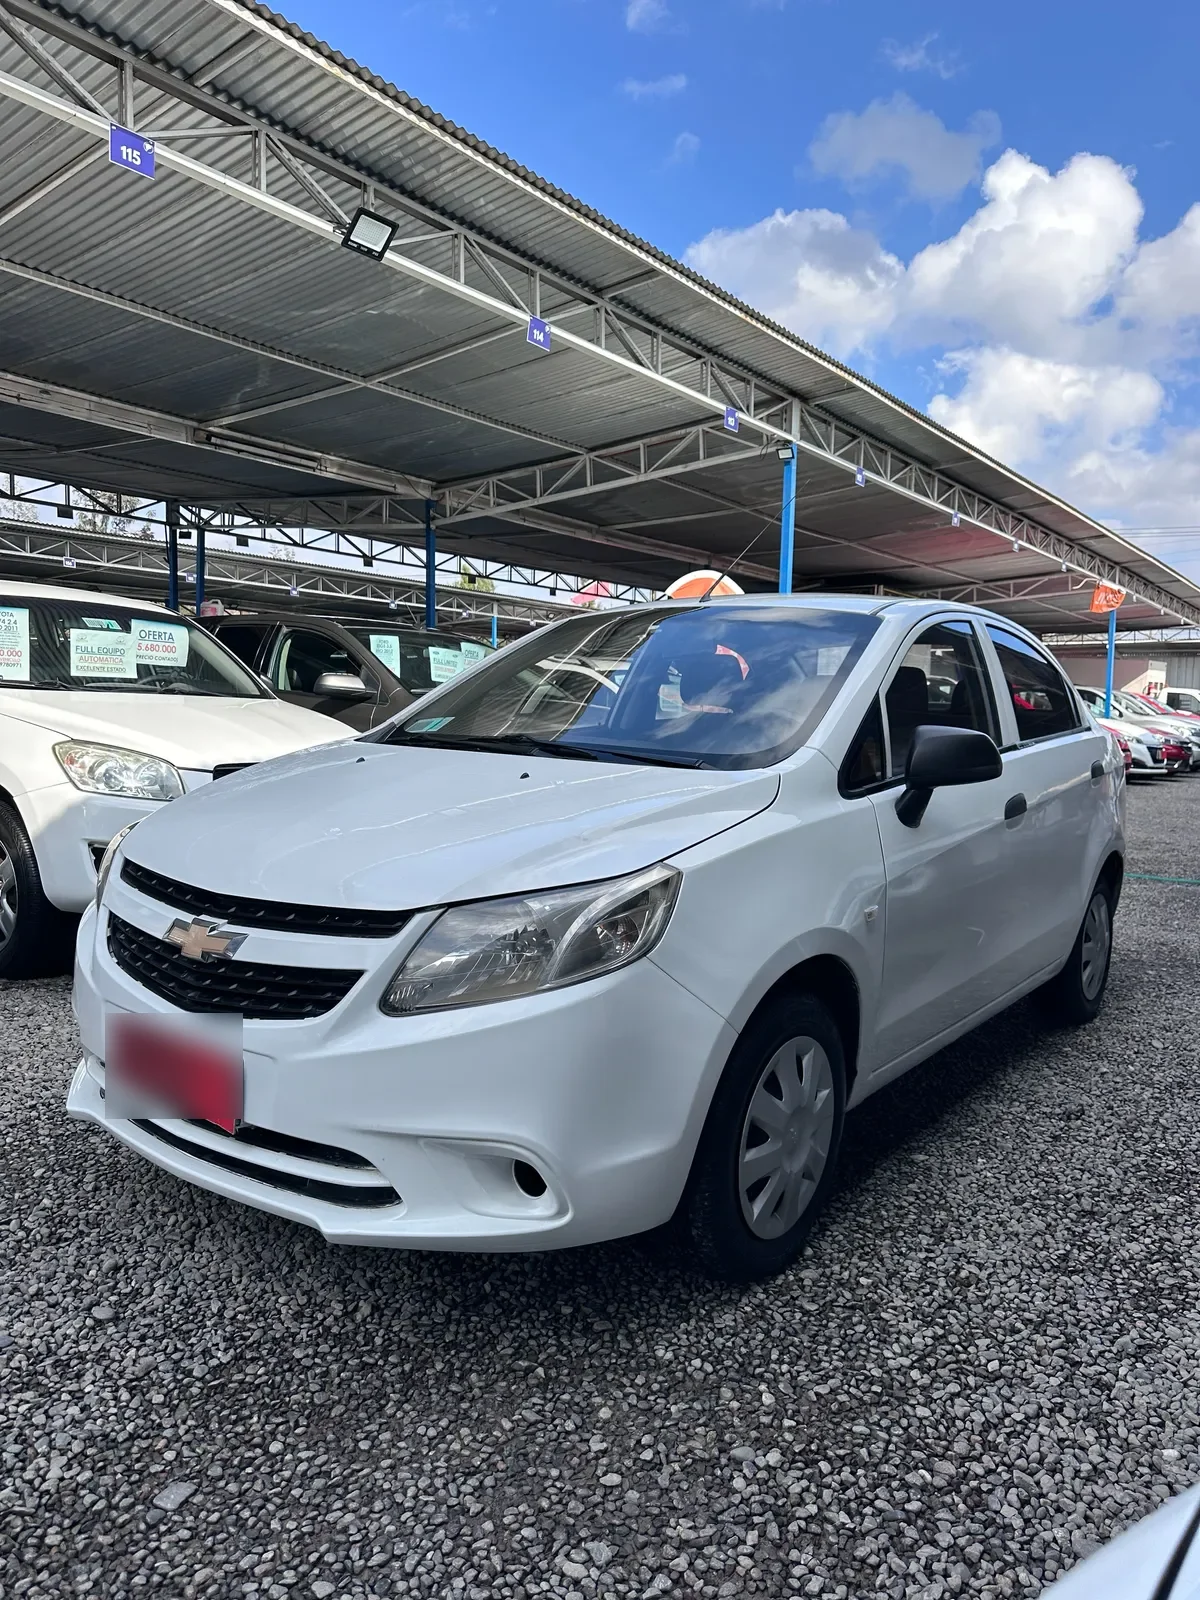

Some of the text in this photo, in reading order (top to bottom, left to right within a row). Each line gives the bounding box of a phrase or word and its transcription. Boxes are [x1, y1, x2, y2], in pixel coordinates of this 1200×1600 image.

[120, 145, 142, 166] 115
[533, 328, 544, 343] 114
[138, 629, 175, 641] OFERTA
[75, 645, 126, 655] FULL EQUIPO
[136, 643, 177, 654] 5.680.000
[79, 655, 124, 664] AUTOMATICA
